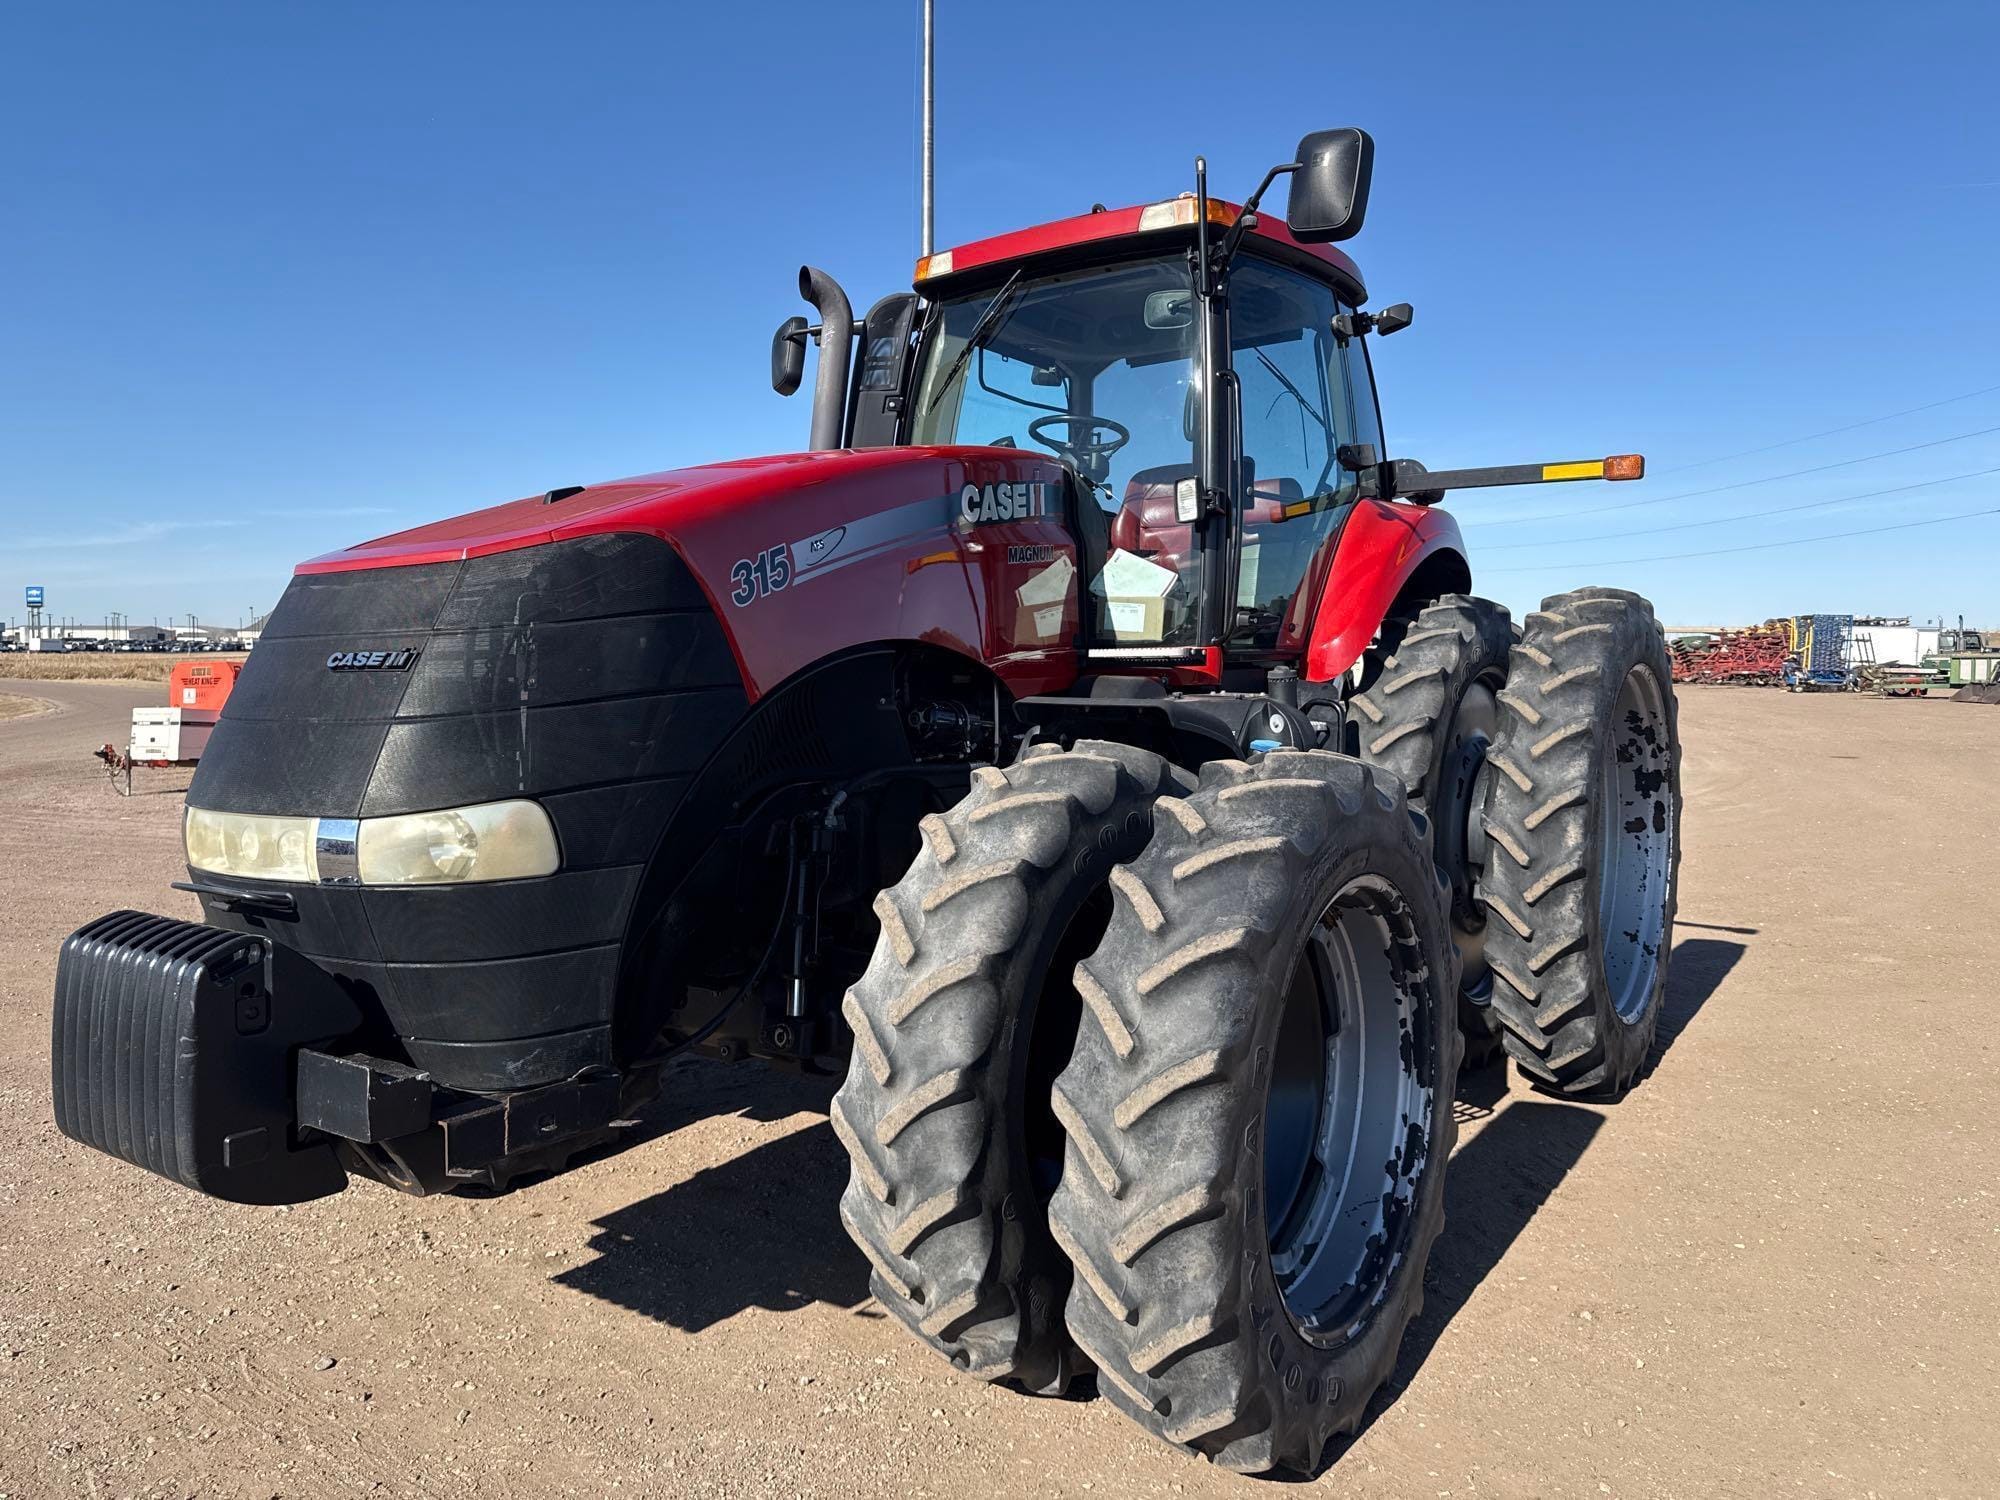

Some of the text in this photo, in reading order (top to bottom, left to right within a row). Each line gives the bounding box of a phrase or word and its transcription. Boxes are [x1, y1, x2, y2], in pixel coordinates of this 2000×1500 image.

[1007, 544, 1054, 565] MAGNUM
[730, 542, 791, 608] 315
[188, 677, 201, 685] HEAT
